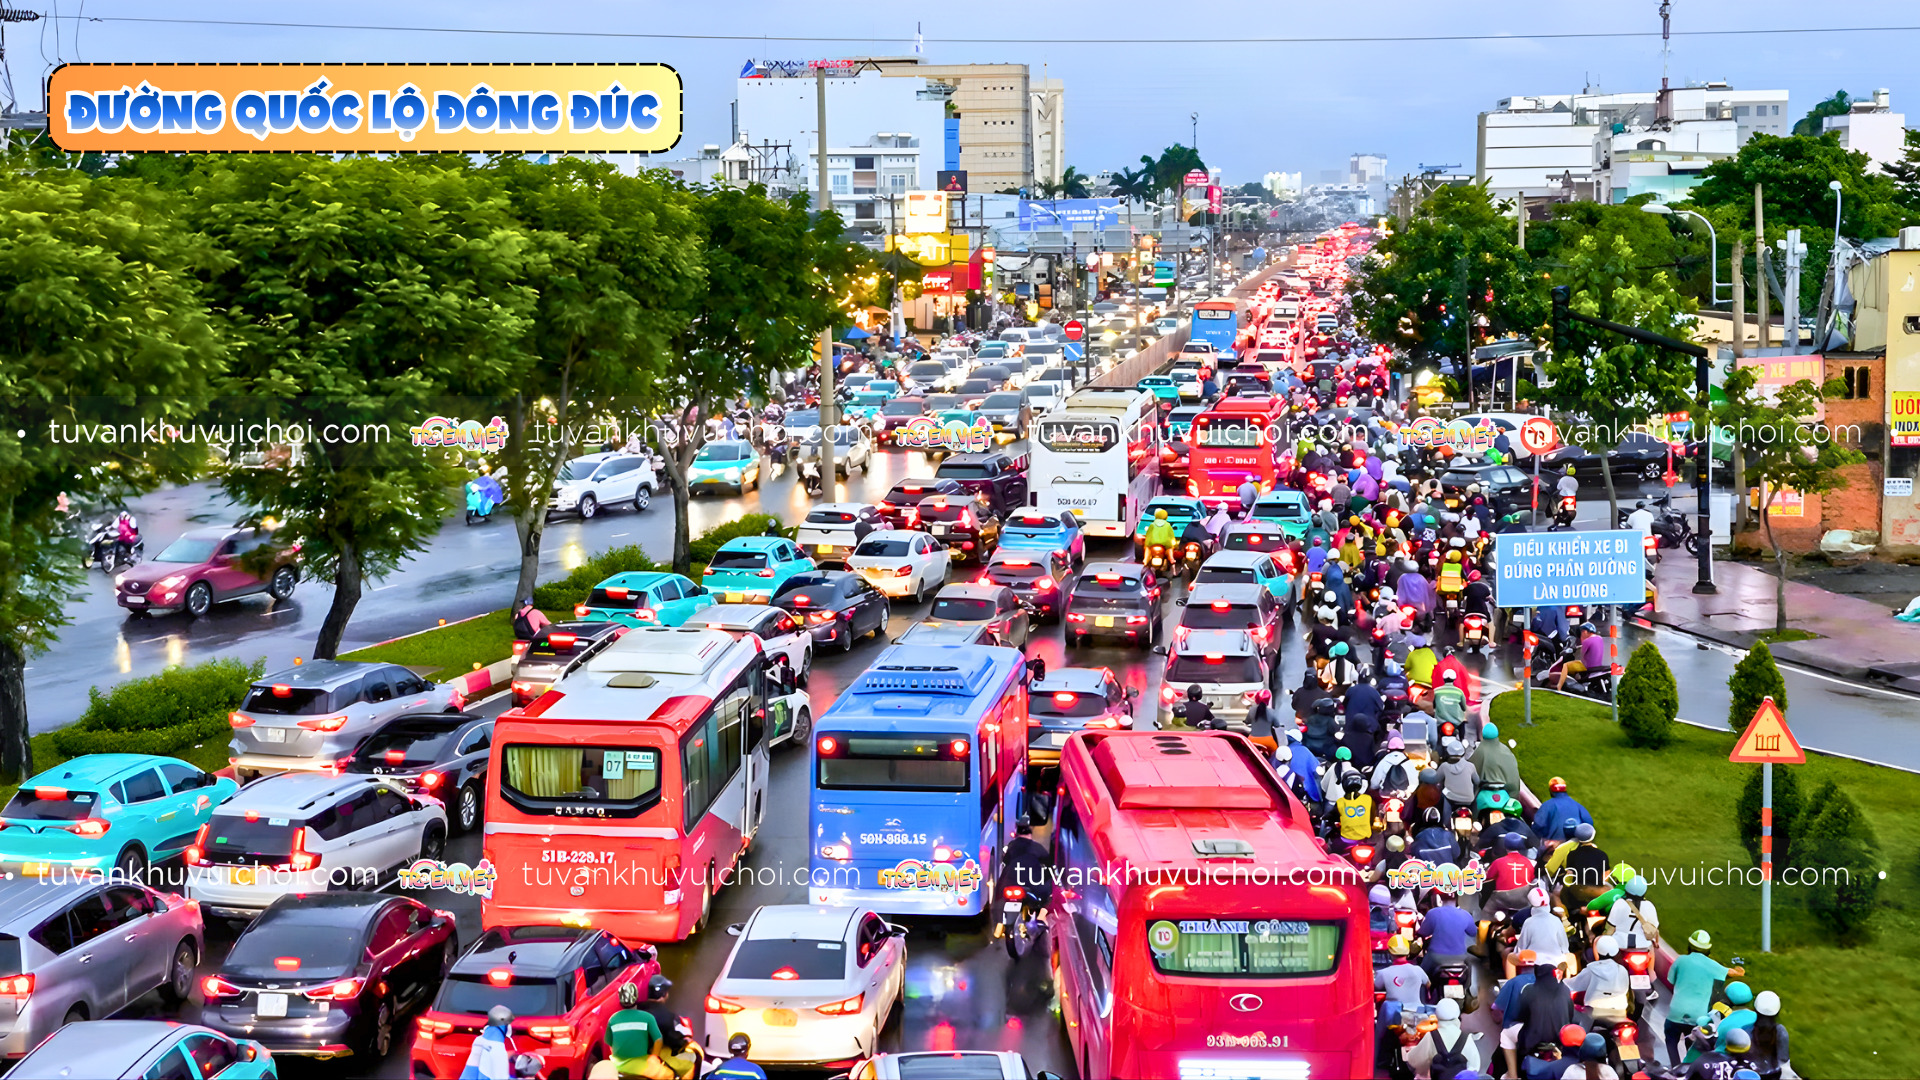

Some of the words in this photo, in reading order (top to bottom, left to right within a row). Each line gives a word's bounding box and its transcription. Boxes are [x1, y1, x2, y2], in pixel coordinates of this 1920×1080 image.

[1593, 539, 1611, 554] XE
[1614, 538, 1628, 553] ĐI
[1533, 582, 1559, 600] LÀN
[606, 760, 621, 772] 07
[541, 850, 615, 864] 51B-229.17
[1179, 918, 1249, 934] THÀNH
[1254, 919, 1310, 935] CÔNG
